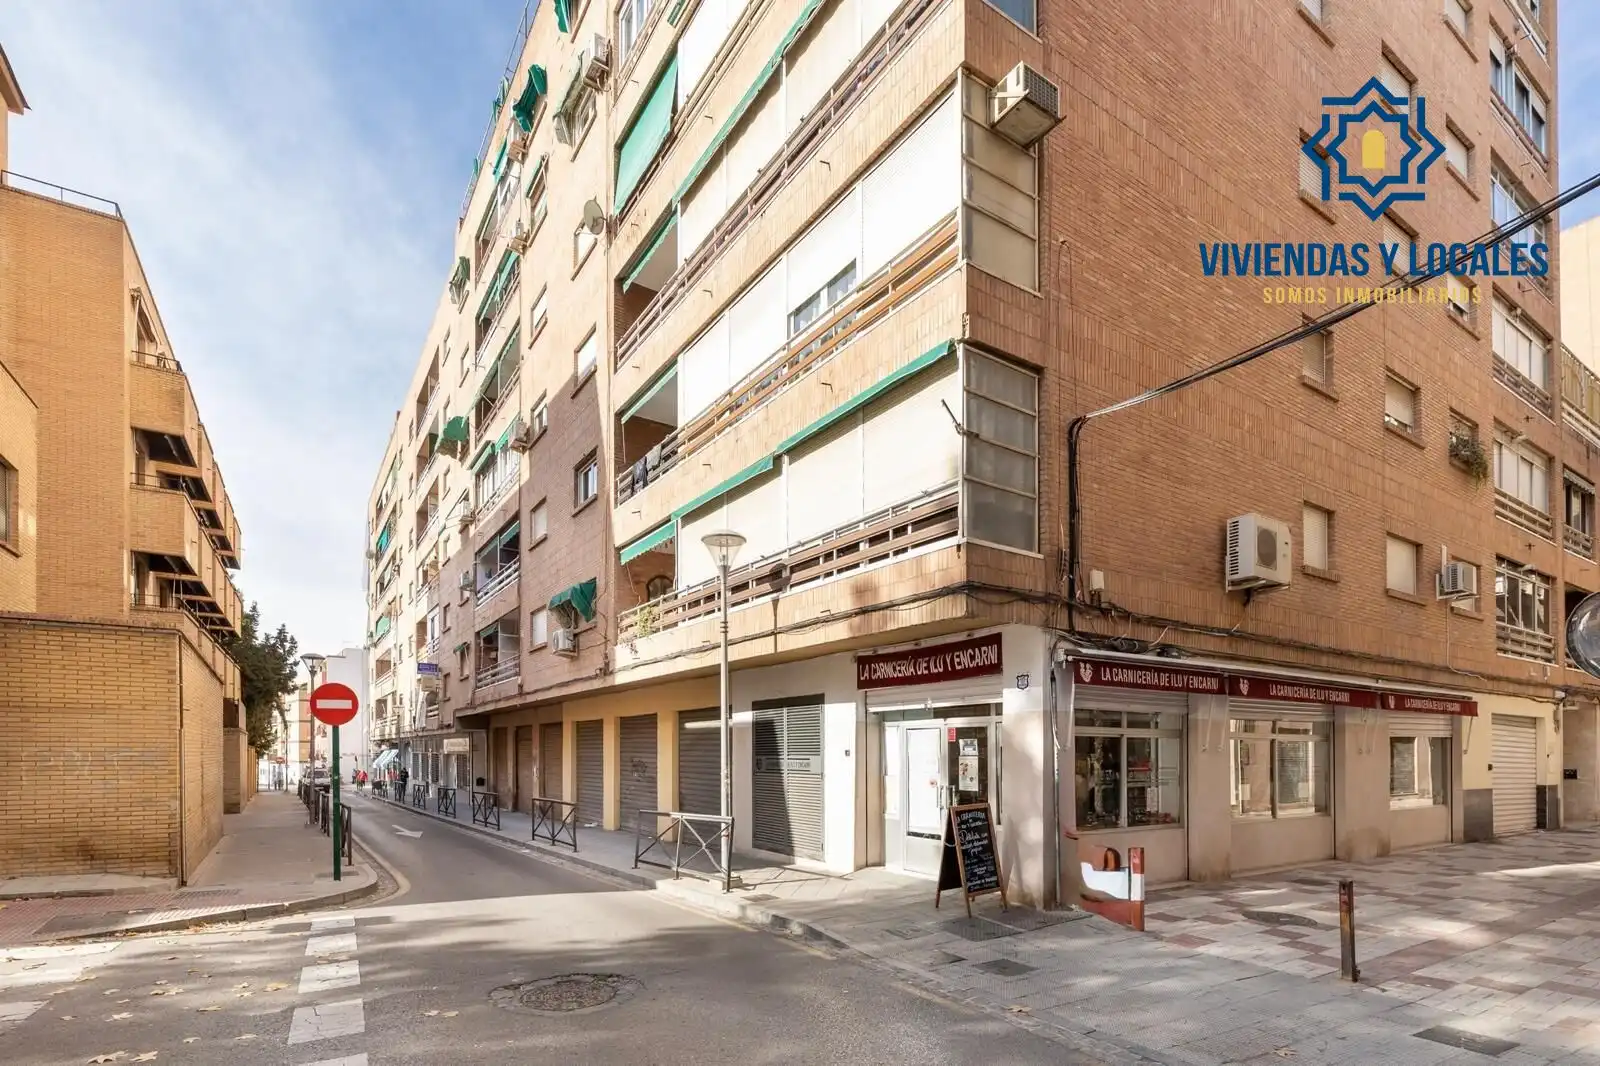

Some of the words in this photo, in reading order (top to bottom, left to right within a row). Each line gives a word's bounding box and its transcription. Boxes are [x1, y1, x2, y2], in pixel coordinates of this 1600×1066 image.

[860, 665, 870, 681] LA
[871, 656, 915, 680] CARNICERÍA
[916, 657, 929, 675] DE
[946, 653, 953, 671] Y
[953, 644, 998, 670] ENCARNI
[1101, 667, 1111, 681] LA
[1112, 667, 1158, 685] CARNICERÍA
[1159, 674, 1170, 686] DE
[1182, 676, 1189, 687] Y
[1189, 677, 1219, 690] ENCARNI
[1269, 683, 1277, 695] LA
[1277, 684, 1309, 698] CARNICERÍA
[1309, 688, 1316, 699] DE
